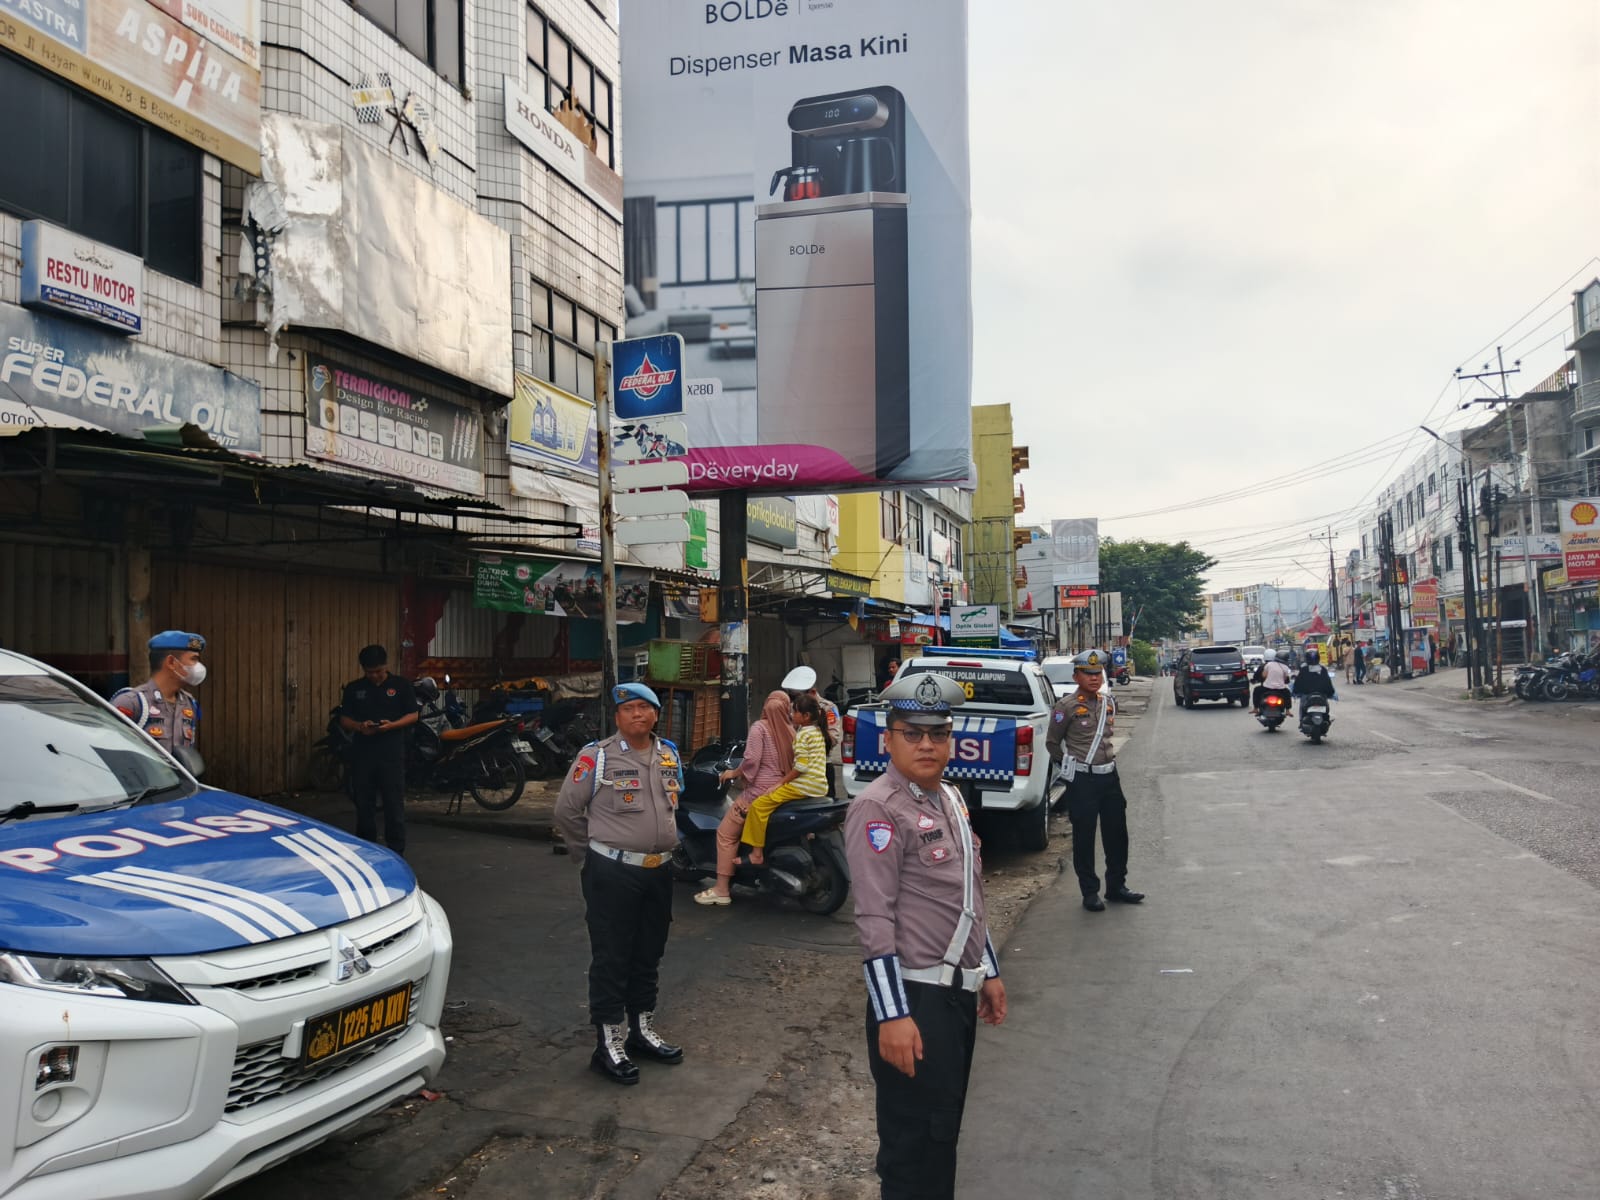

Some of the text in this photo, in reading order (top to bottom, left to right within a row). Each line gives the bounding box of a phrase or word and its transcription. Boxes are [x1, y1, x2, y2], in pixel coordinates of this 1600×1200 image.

[18, 0, 79, 42] ASTRA
[706, 0, 788, 24] BOLDë
[670, 33, 908, 77] Dispenser Masa Kini
[516, 98, 576, 161] HONDA
[789, 243, 825, 256] BOLDë
[47, 256, 89, 290] RESTU
[93, 273, 135, 306] MOTOR
[8, 335, 65, 364] SUPER
[0, 352, 241, 438] FEDERAL OIL
[334, 369, 411, 409] TERMIGNONI
[623, 372, 671, 387] FEDERAL OIL
[336, 387, 429, 428] Design For Racing
[687, 458, 799, 482] Dëveryday
[1568, 560, 1597, 568] MOTOR
[957, 671, 976, 681] POLDA
[977, 673, 1006, 681] LAMPUNG
[0, 808, 300, 873] POLISI
[342, 1004, 369, 1046] 1225
[369, 998, 385, 1034] 99
